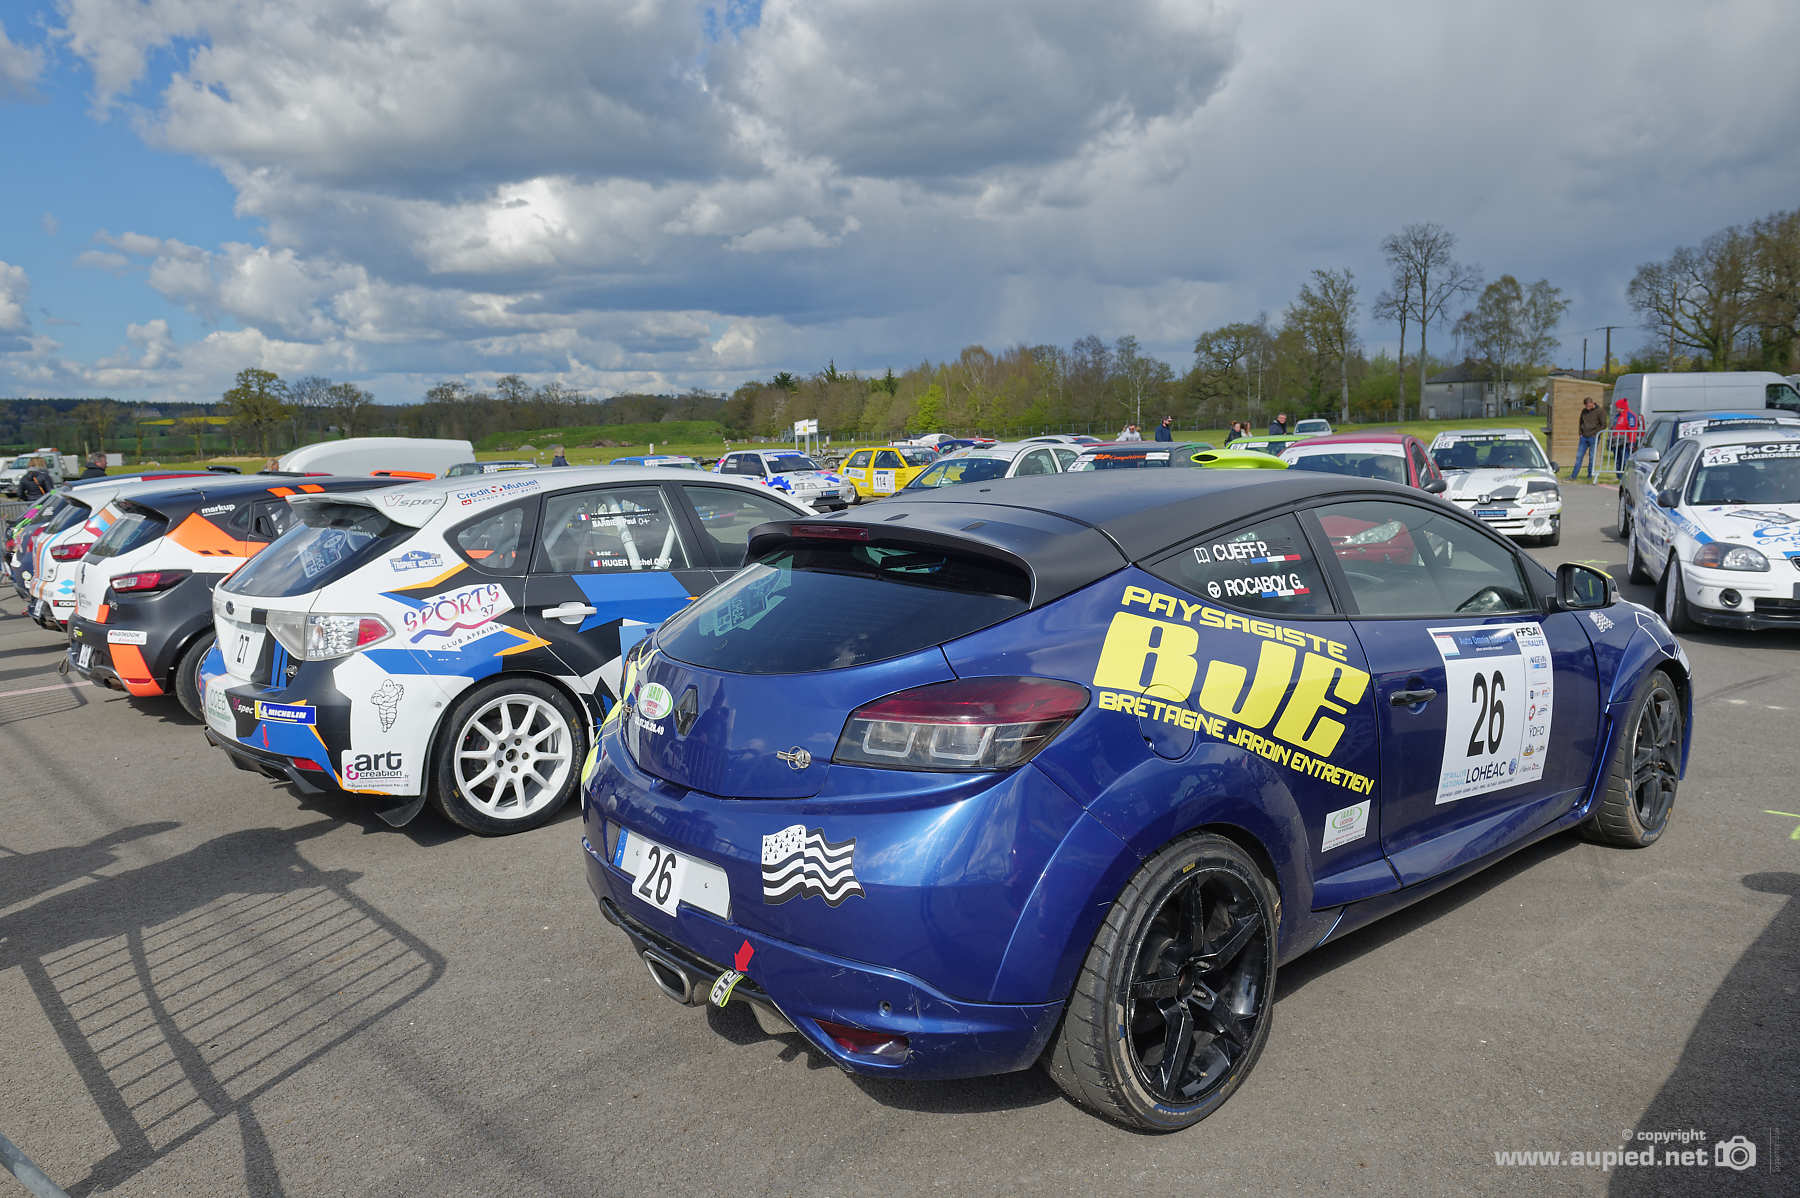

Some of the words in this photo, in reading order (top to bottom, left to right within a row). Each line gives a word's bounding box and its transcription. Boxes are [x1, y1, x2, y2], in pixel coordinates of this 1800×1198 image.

[1708, 455, 1731, 465] 45
[876, 476, 887, 489] 114
[201, 503, 236, 515] markup
[1212, 541, 1256, 561] CUEFF
[1256, 541, 1271, 557] P.
[602, 558, 628, 567] HUGER
[1223, 574, 1288, 597] ROCABOY
[1289, 573, 1305, 590] G.
[480, 604, 495, 618] 37
[1121, 585, 1348, 662] PAYSAGISTE
[1515, 626, 1540, 637] FFSA
[236, 633, 250, 665] 27
[441, 638, 464, 650] CLUB
[267, 708, 307, 719] MICHELIN
[1466, 671, 1506, 758] 26
[1098, 691, 1228, 738] BRETAGNE
[1228, 727, 1292, 769] JARDIN
[1290, 751, 1375, 796] ENTRETIEN
[354, 750, 402, 771] art
[1465, 760, 1507, 784] LOHÉAC
[638, 845, 677, 906] 26
